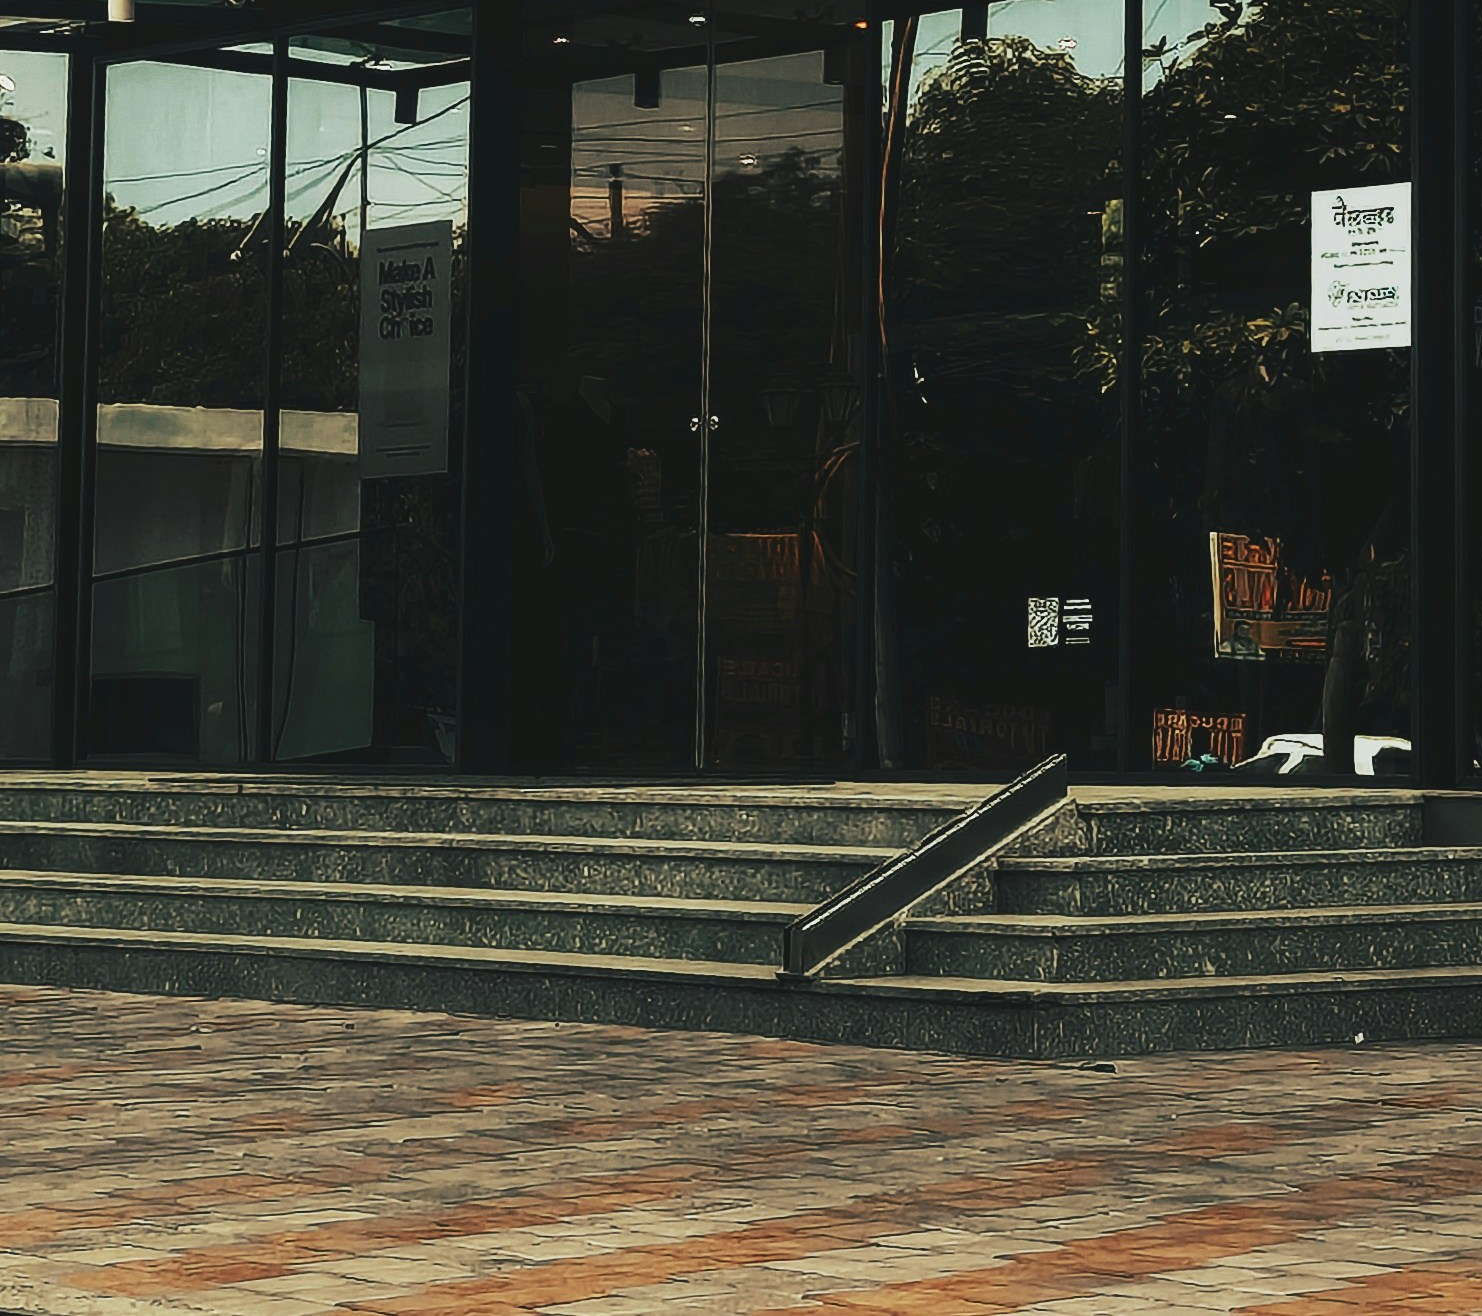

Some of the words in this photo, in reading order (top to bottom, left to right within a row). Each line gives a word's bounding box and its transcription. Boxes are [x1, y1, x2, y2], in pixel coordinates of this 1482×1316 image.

[378, 259, 421, 286] Make
[423, 256, 436, 281] A
[380, 284, 434, 317] Stylish
[379, 312, 434, 340] Chice
